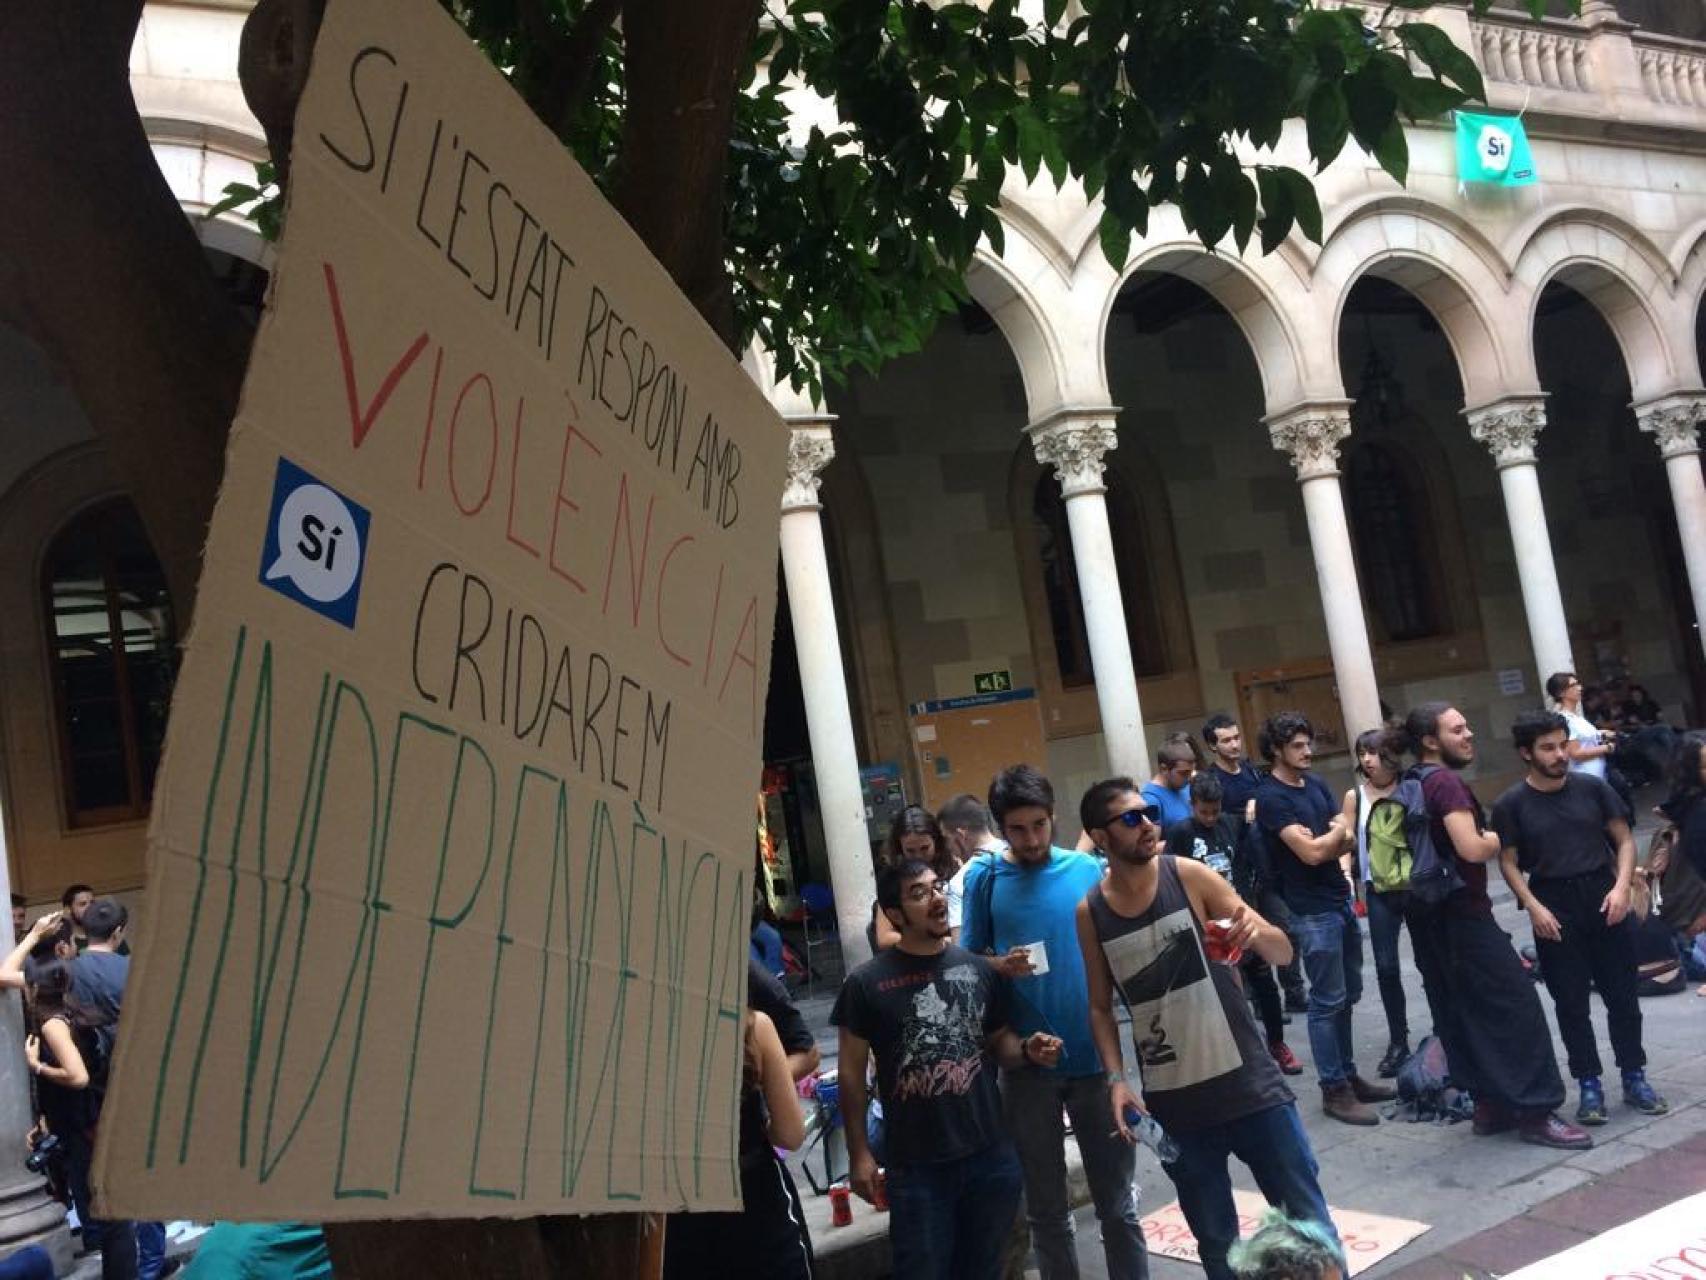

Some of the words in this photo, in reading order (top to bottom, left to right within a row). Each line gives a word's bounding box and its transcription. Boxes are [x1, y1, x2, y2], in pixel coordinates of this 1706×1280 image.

[320, 47, 408, 193] SI
[416, 119, 575, 360] L'ESTAT
[578, 285, 687, 473] RESPON
[686, 413, 741, 529] AMB
[324, 263, 758, 738] VIOLÈNCIA
[146, 624, 744, 1200] INDEPENDÈNCIA
[413, 562, 671, 814] CRIDAREM
